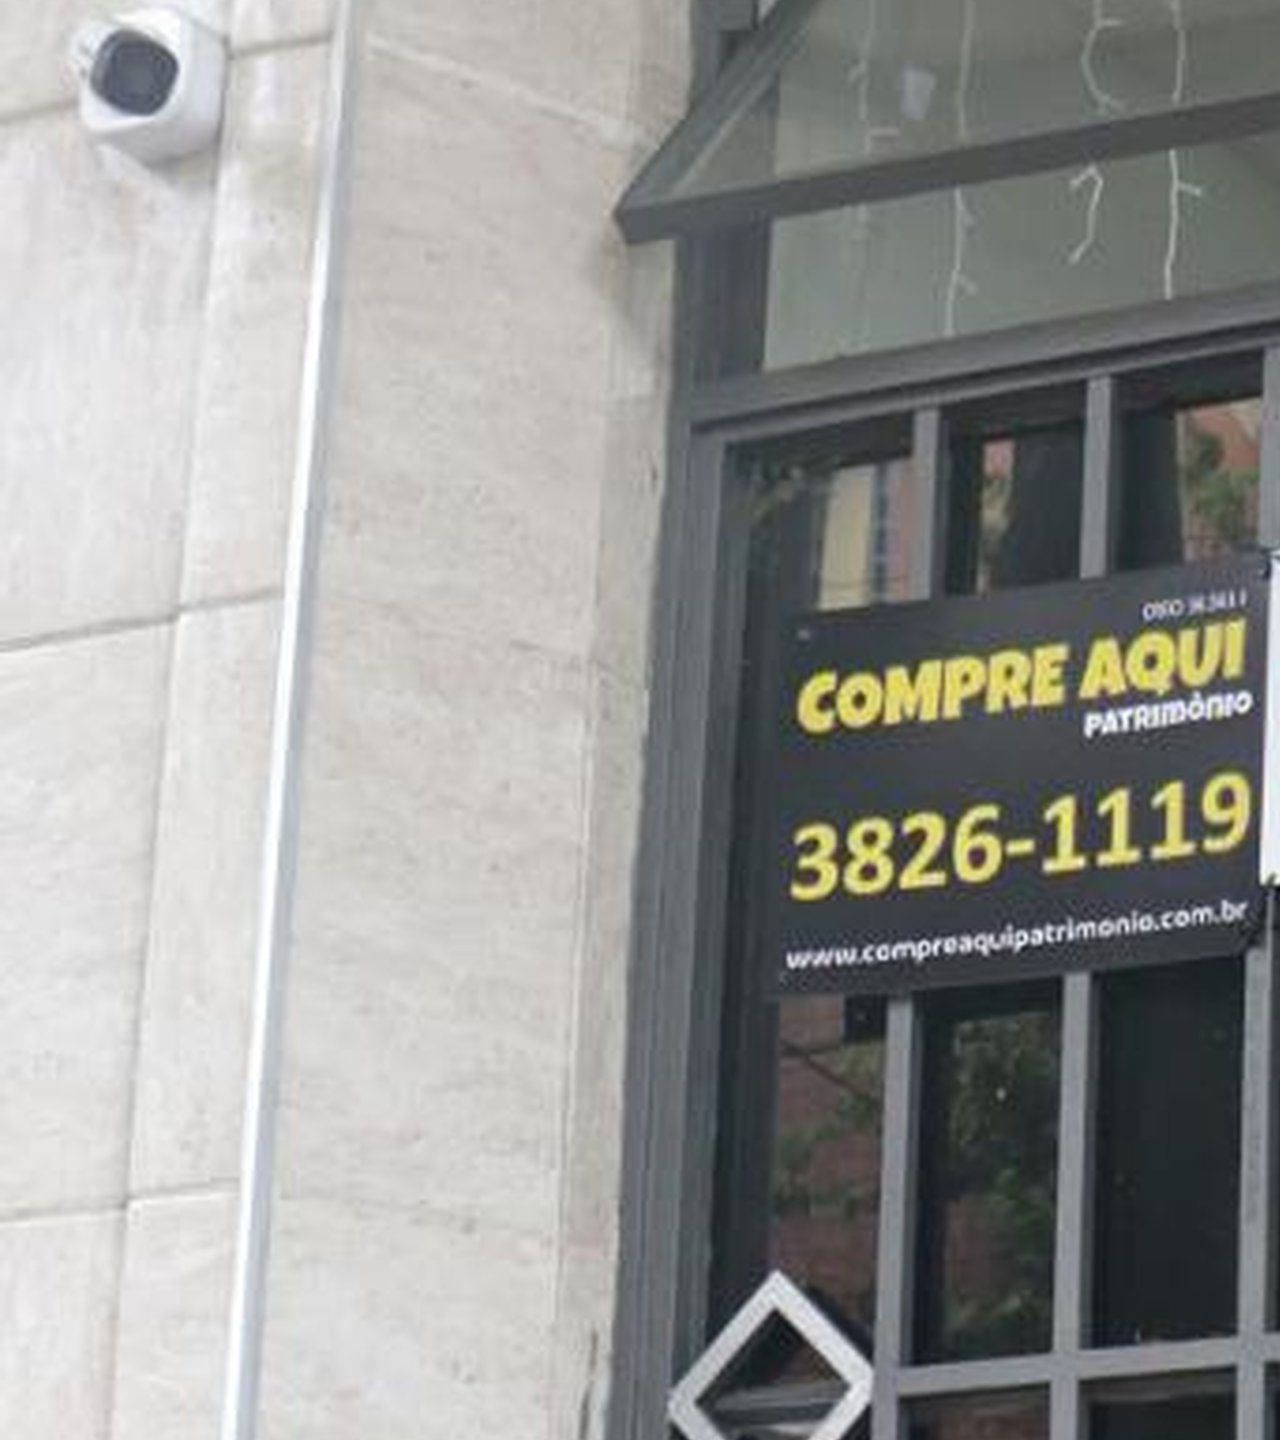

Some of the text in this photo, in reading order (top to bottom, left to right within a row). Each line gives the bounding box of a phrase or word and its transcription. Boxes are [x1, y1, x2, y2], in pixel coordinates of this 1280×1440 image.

[796, 643, 1069, 735] COMPRE
[1079, 617, 1249, 699] AQUI
[787, 770, 1254, 904] 3826-1119
[785, 898, 1250, 972] www.compreaquipatrimonio.com.br
